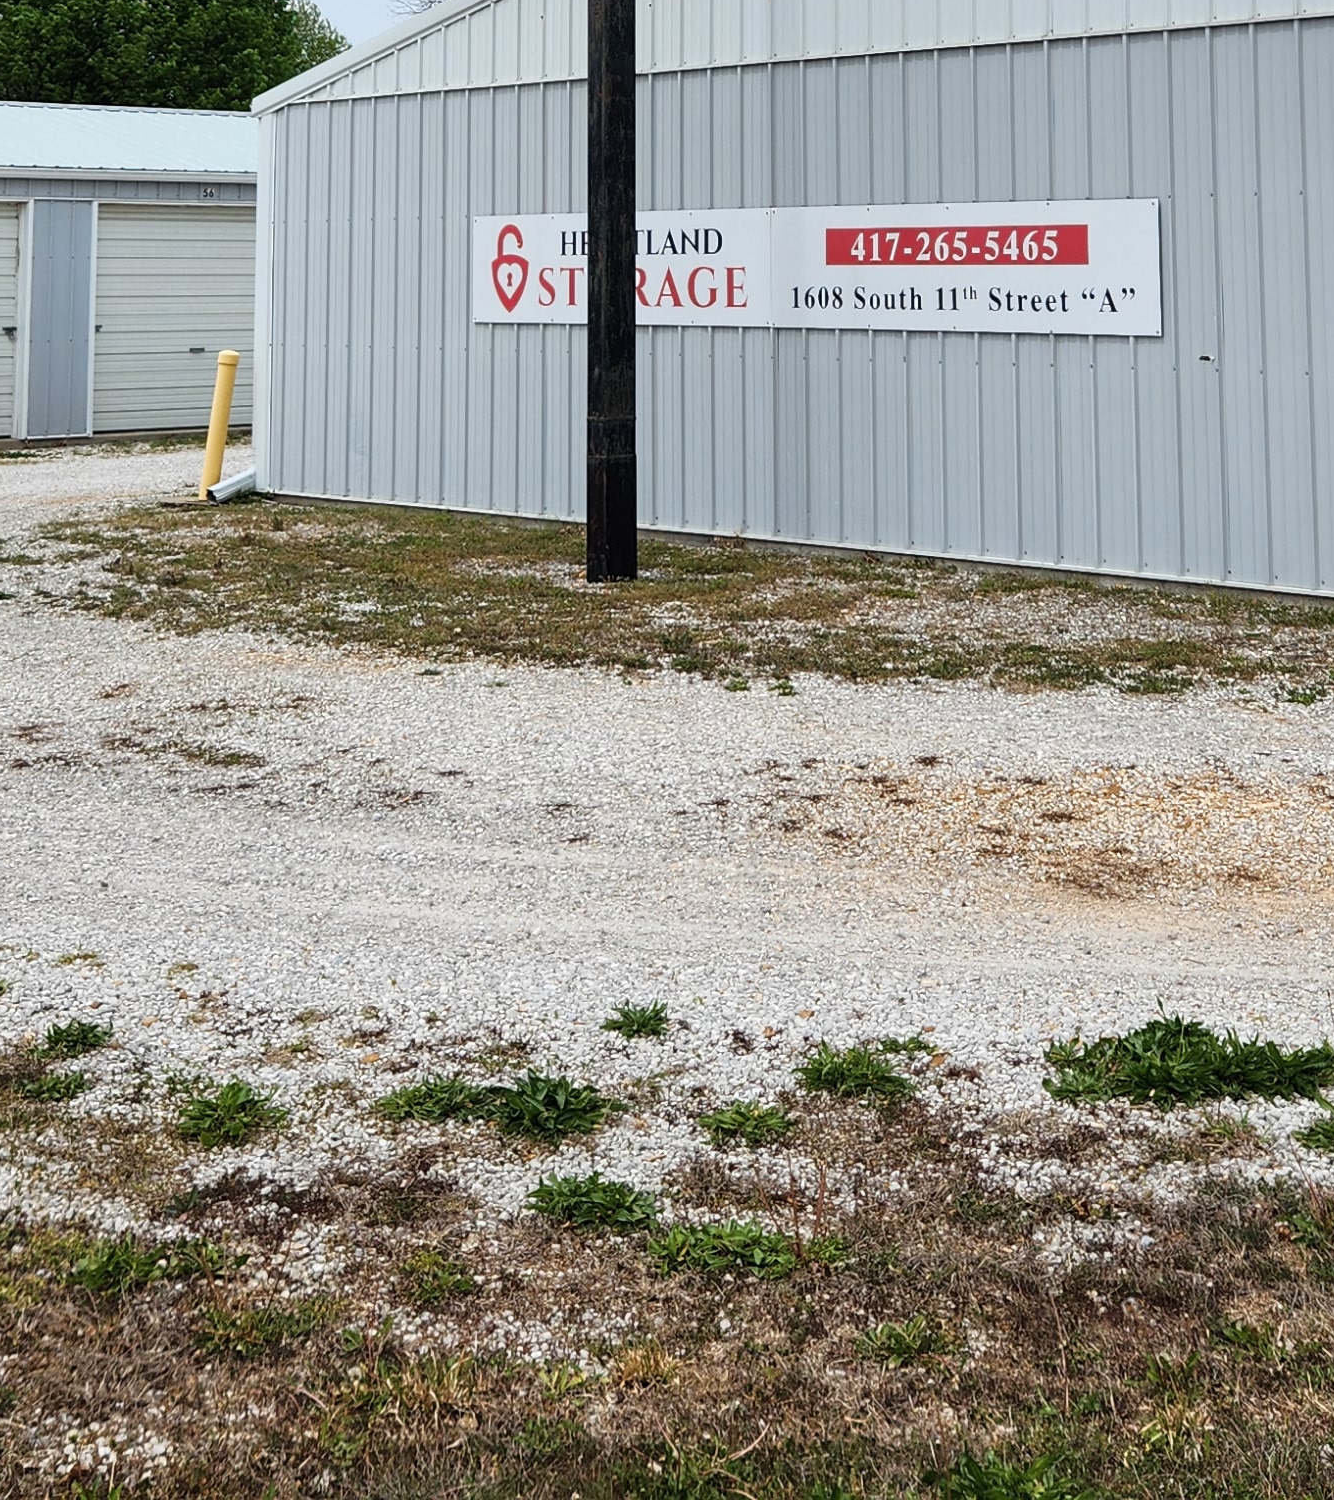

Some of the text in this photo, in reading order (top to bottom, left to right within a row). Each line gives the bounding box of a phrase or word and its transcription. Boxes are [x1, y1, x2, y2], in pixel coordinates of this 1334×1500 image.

[202, 187, 214, 198] 56
[560, 228, 723, 256] HETLAND
[850, 230, 1058, 262] 417-265-5465
[538, 266, 748, 308] STRAGE
[790, 285, 844, 310] 1608
[853, 286, 923, 311] South
[934, 285, 978, 311] 11th
[987, 287, 1069, 313] Street
